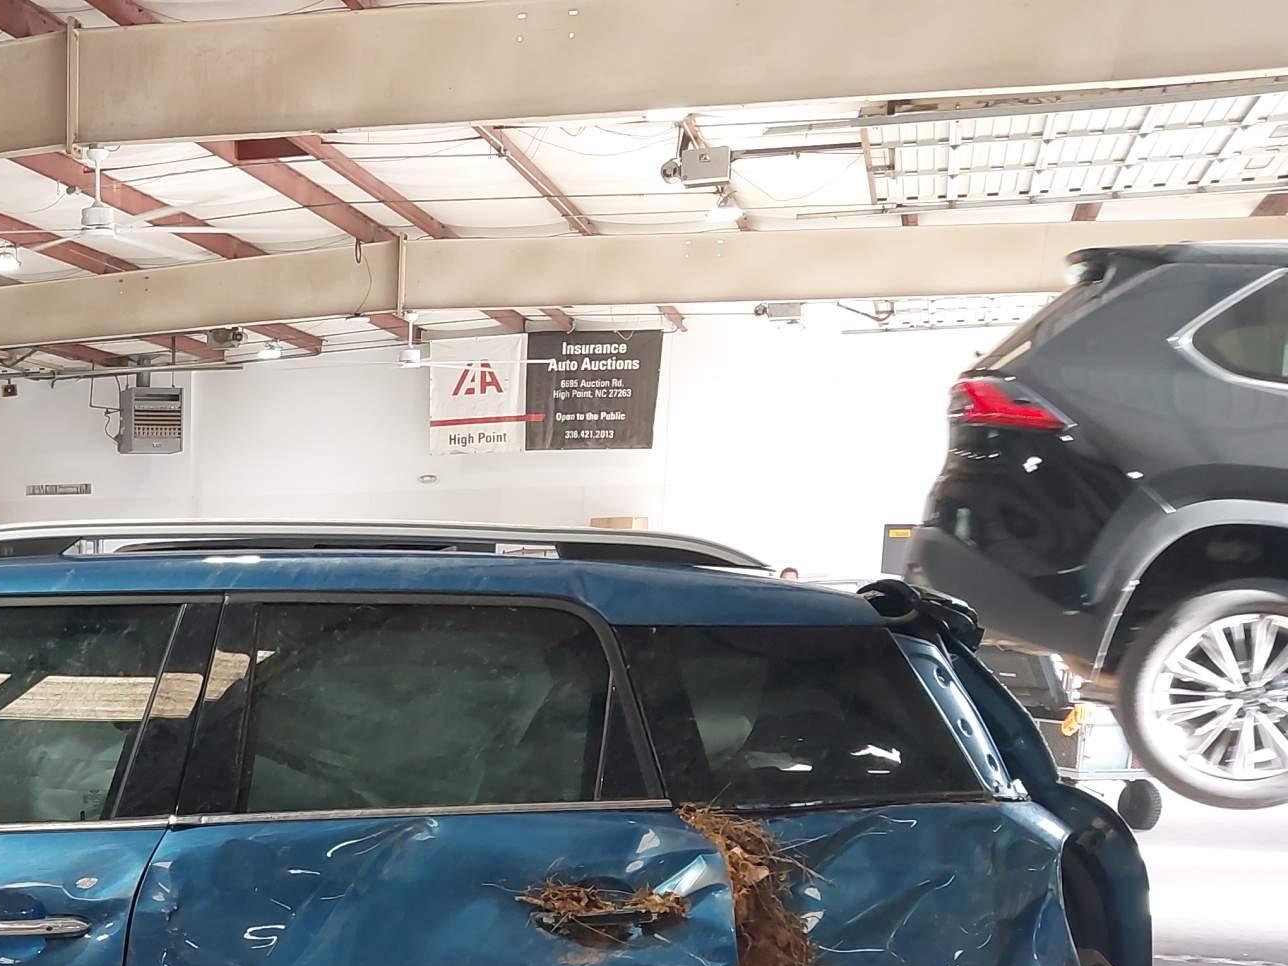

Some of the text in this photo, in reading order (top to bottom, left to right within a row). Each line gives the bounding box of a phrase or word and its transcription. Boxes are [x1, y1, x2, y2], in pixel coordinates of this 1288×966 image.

[562, 342, 627, 355] Insurance
[548, 357, 640, 372] Auto Auctions
[580, 378, 610, 387] Auction
[553, 390, 570, 400] High
[595, 389, 607, 397] NC
[608, 389, 632, 397] 27263
[556, 412, 575, 423] Open
[586, 412, 599, 420] the
[600, 411, 626, 420] Public
[449, 432, 507, 447] High Point
